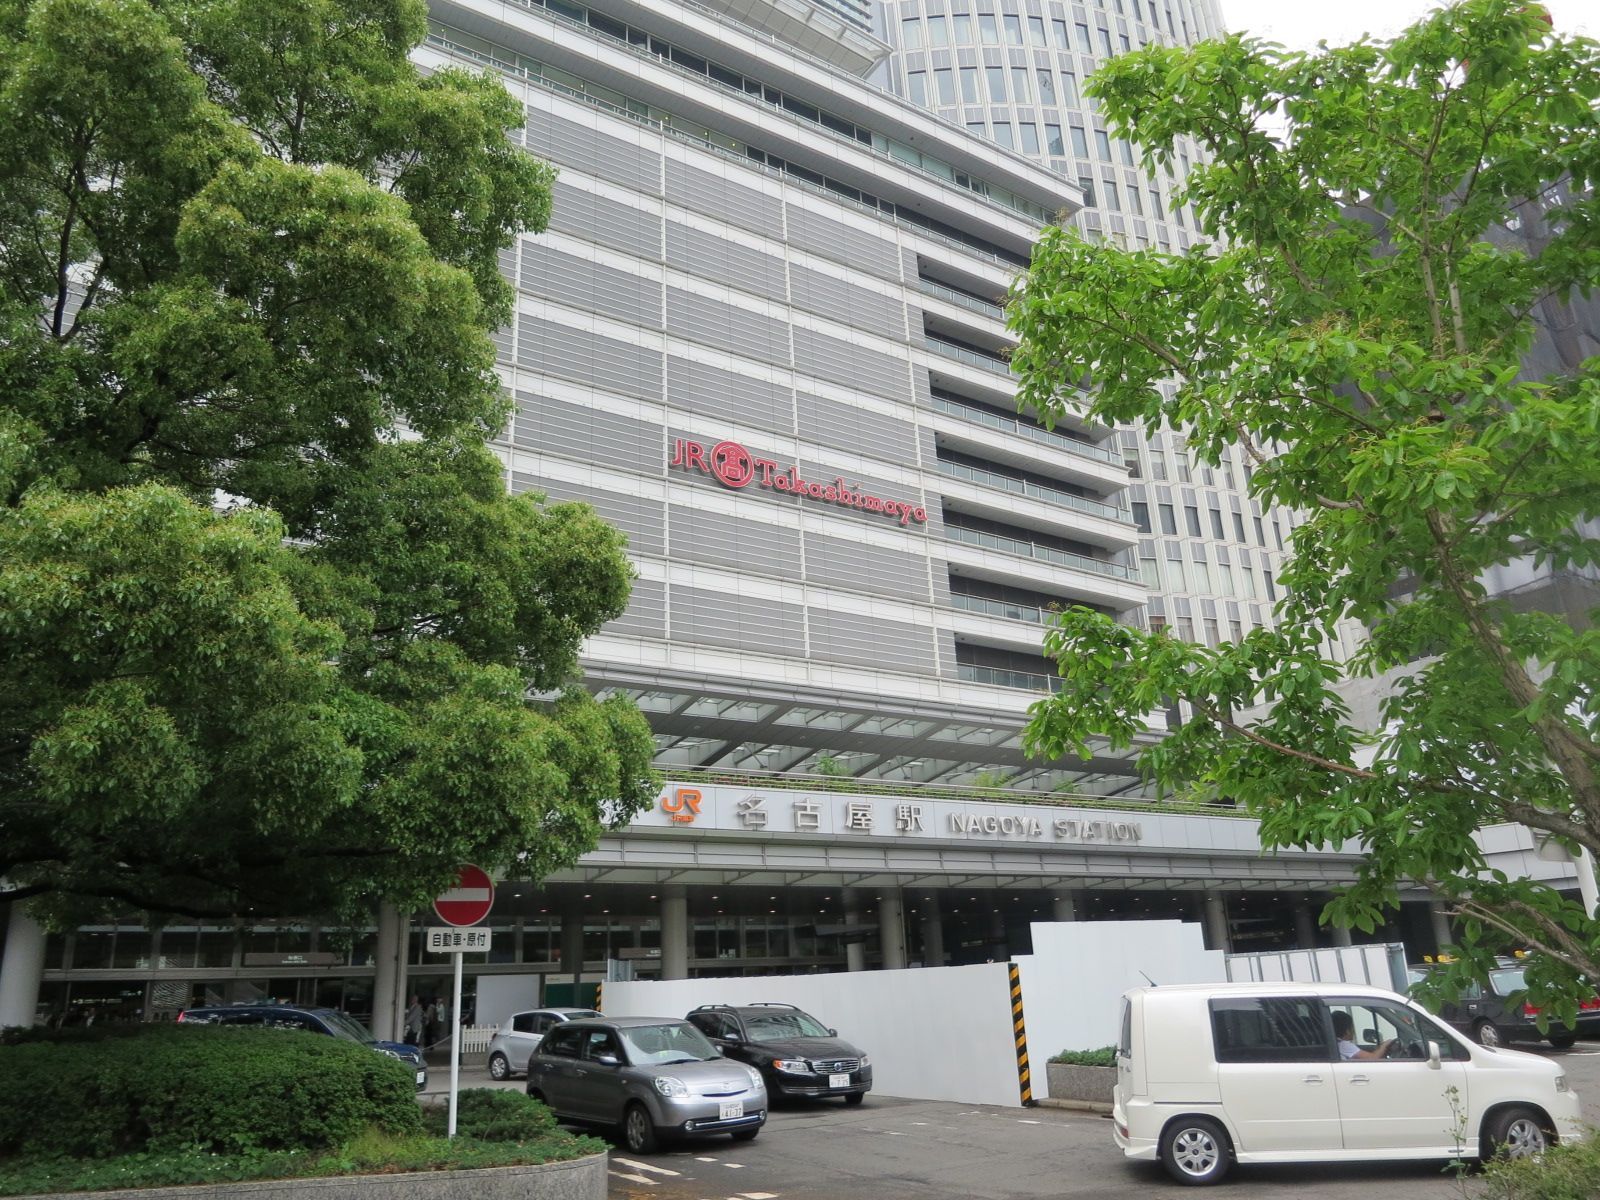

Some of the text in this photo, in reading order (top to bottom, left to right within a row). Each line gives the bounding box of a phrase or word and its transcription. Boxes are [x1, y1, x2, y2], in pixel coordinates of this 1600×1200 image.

[671, 438, 709, 472] JR
[755, 458, 927, 524] Takashimaya
[661, 788, 702, 814] JR
[737, 794, 925, 833] 名古屋駅
[949, 812, 1143, 841] NAGOYA STATION
[432, 932, 486, 947] 自動車・原付
